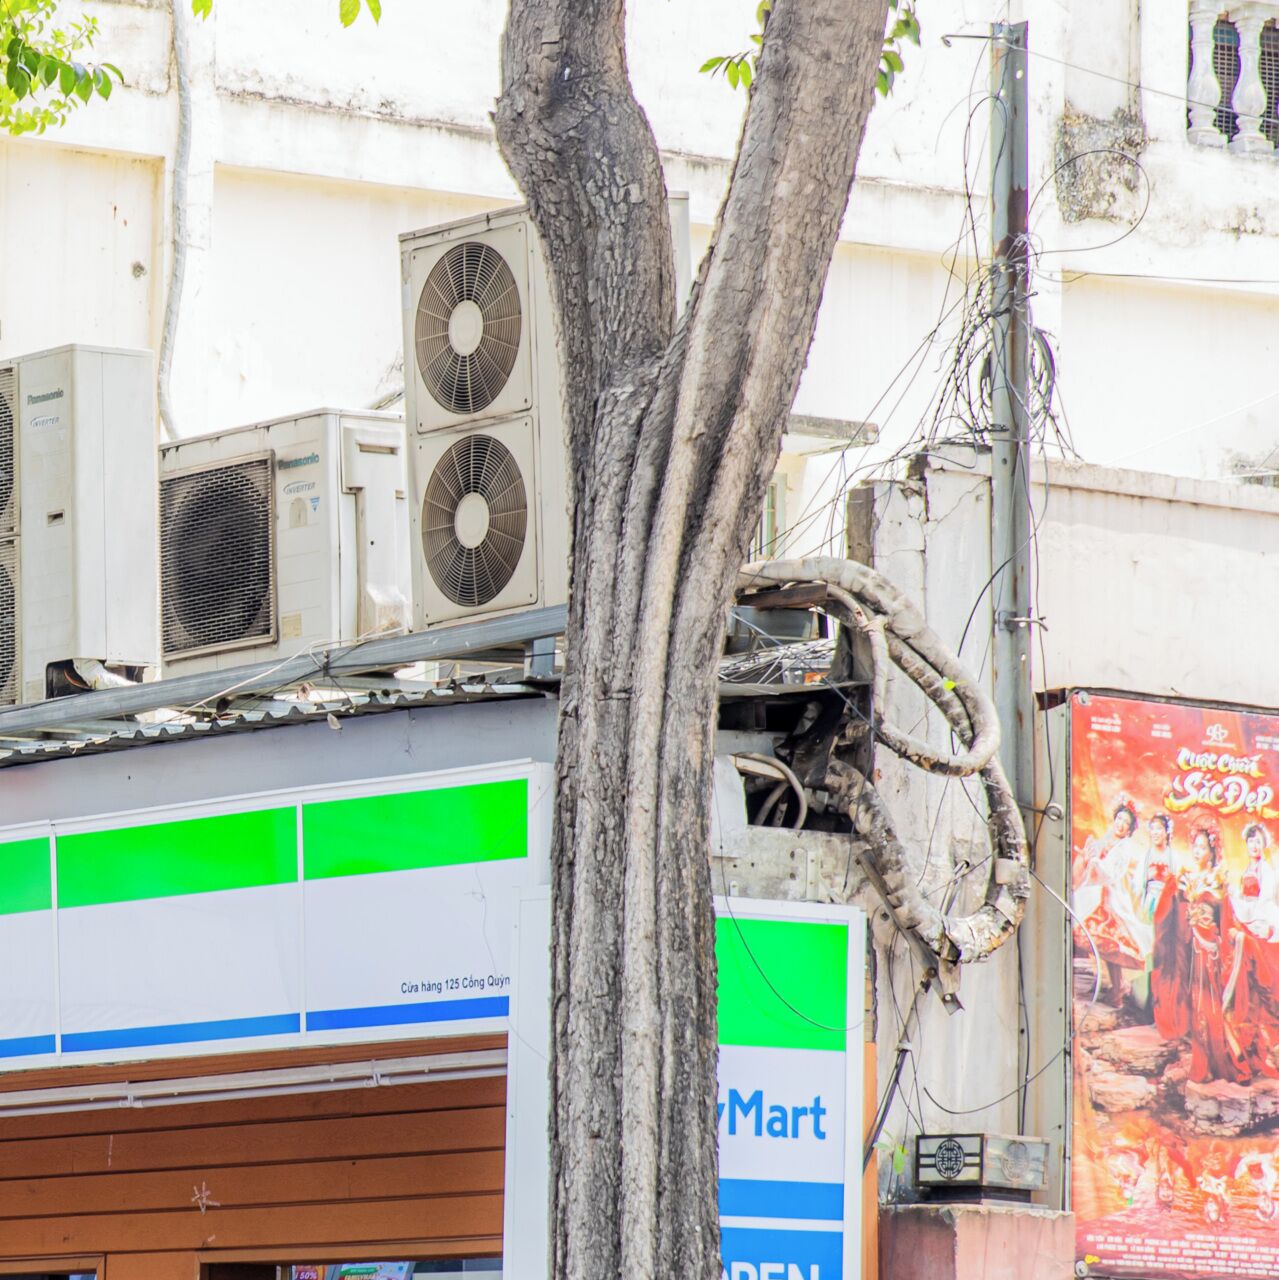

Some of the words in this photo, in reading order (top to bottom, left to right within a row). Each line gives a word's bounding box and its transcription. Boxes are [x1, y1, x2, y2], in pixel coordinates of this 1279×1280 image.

[27, 388, 64, 405] Panasonic
[278, 452, 320, 470] Panasonic
[1165, 771, 1225, 813] Sắc
[1219, 775, 1277, 816] Đẹp
[445, 978, 460, 990] 125
